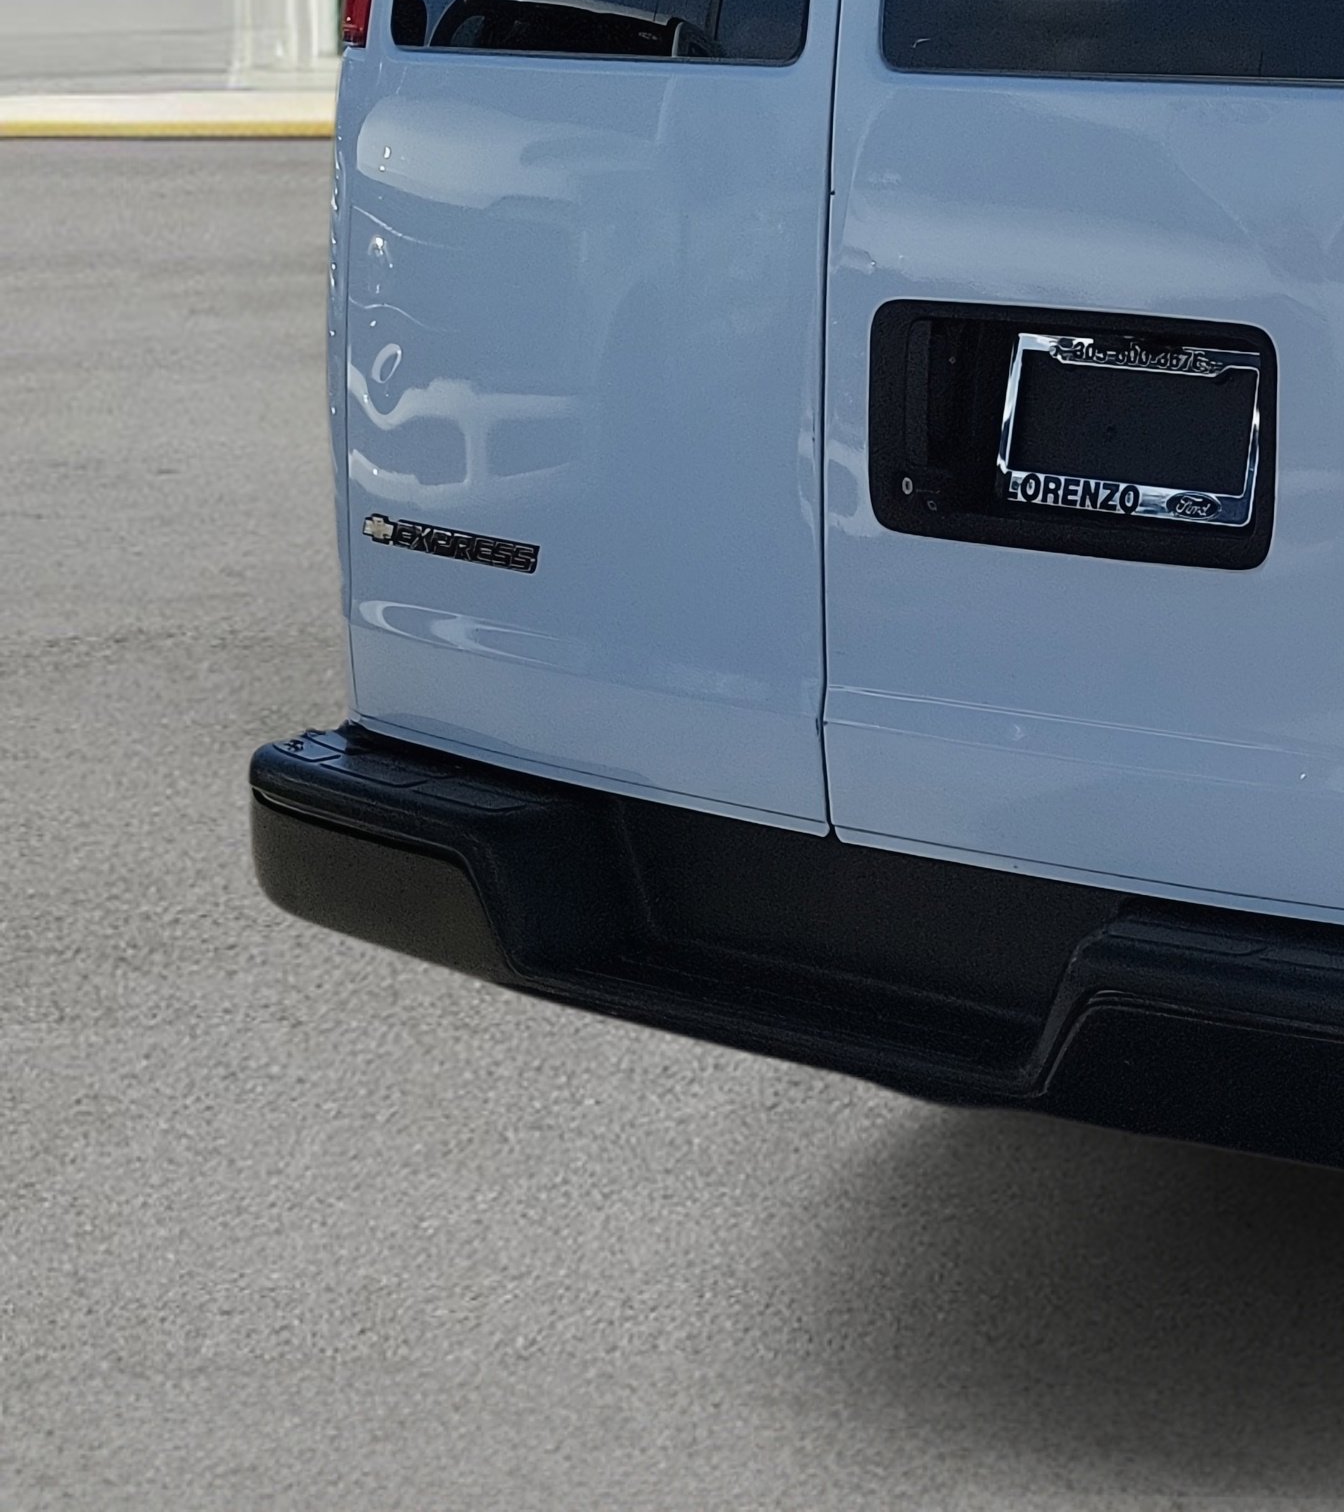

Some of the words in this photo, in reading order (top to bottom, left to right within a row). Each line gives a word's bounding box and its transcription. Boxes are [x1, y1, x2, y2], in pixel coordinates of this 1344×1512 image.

[1007, 473, 1140, 514] LORENZO
[1175, 494, 1211, 517] Ford
[394, 521, 537, 572] EXPRESS
